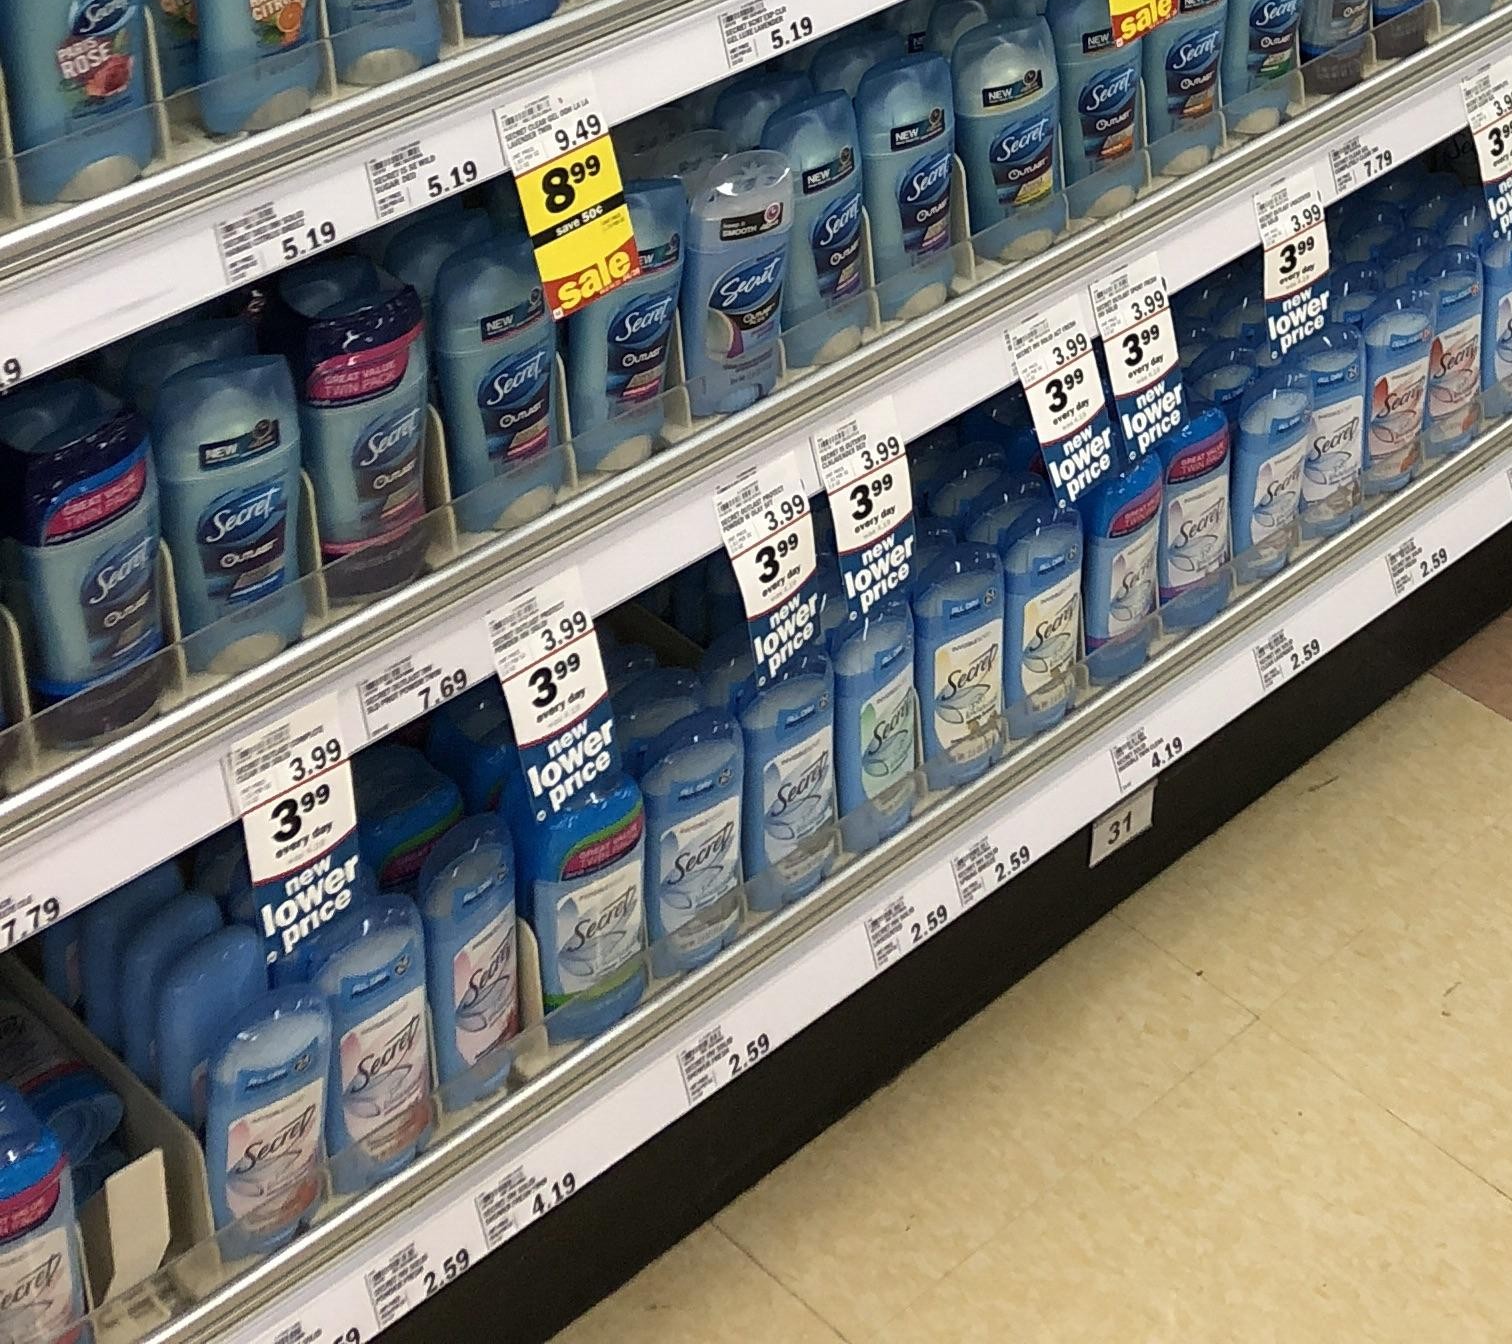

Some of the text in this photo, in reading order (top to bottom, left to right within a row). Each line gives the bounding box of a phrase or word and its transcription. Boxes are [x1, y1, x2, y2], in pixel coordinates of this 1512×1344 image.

[60, 43, 111, 80] ROSE
[554, 115, 602, 151] 9.49
[1364, 150, 1393, 178] 7.79
[555, 217, 581, 238] save
[558, 248, 633, 310] sale
[861, 437, 901, 471] 3.99
[764, 495, 805, 530] 3.99
[855, 504, 896, 536] every day
[844, 533, 915, 598] lower
[862, 535, 895, 566] new
[859, 563, 910, 615] price
[753, 591, 819, 664] lower
[769, 598, 801, 628] new
[768, 627, 816, 679] price
[417, 668, 468, 713] 7.69
[1151, 738, 1183, 771] 4.19
[1107, 813, 1133, 846] 31
[994, 845, 1030, 882] 2.59
[910, 904, 949, 944] 2.59
[729, 1034, 770, 1076] 2.59
[530, 1172, 577, 1217] 4.19
